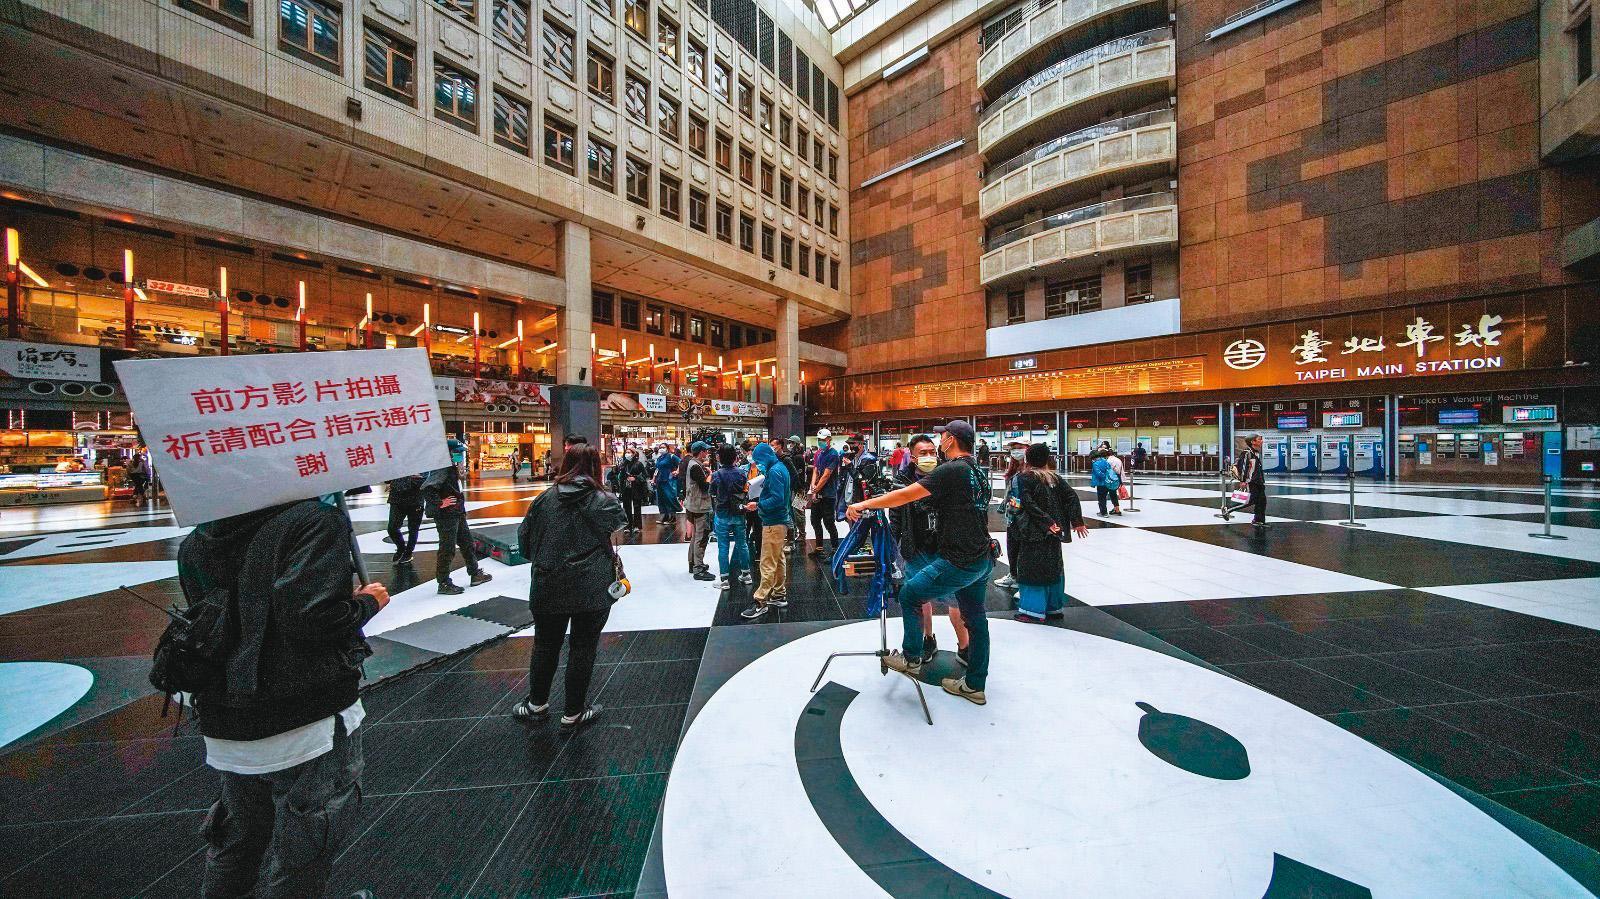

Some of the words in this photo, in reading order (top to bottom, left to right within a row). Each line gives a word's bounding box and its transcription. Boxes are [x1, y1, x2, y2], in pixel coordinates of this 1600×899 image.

[1290, 314, 1503, 365] 臺北車站
[1294, 368, 1346, 381] TAIPEI
[1357, 364, 1403, 377] MAIN
[1416, 357, 1502, 372] STATION
[190, 374, 402, 415] 前方影片拍攝
[1412, 397, 1448, 405] Tickets
[1453, 395, 1491, 404] Vending
[1497, 392, 1539, 401] Machine
[162, 403, 432, 461] 祈請配合指示通行
